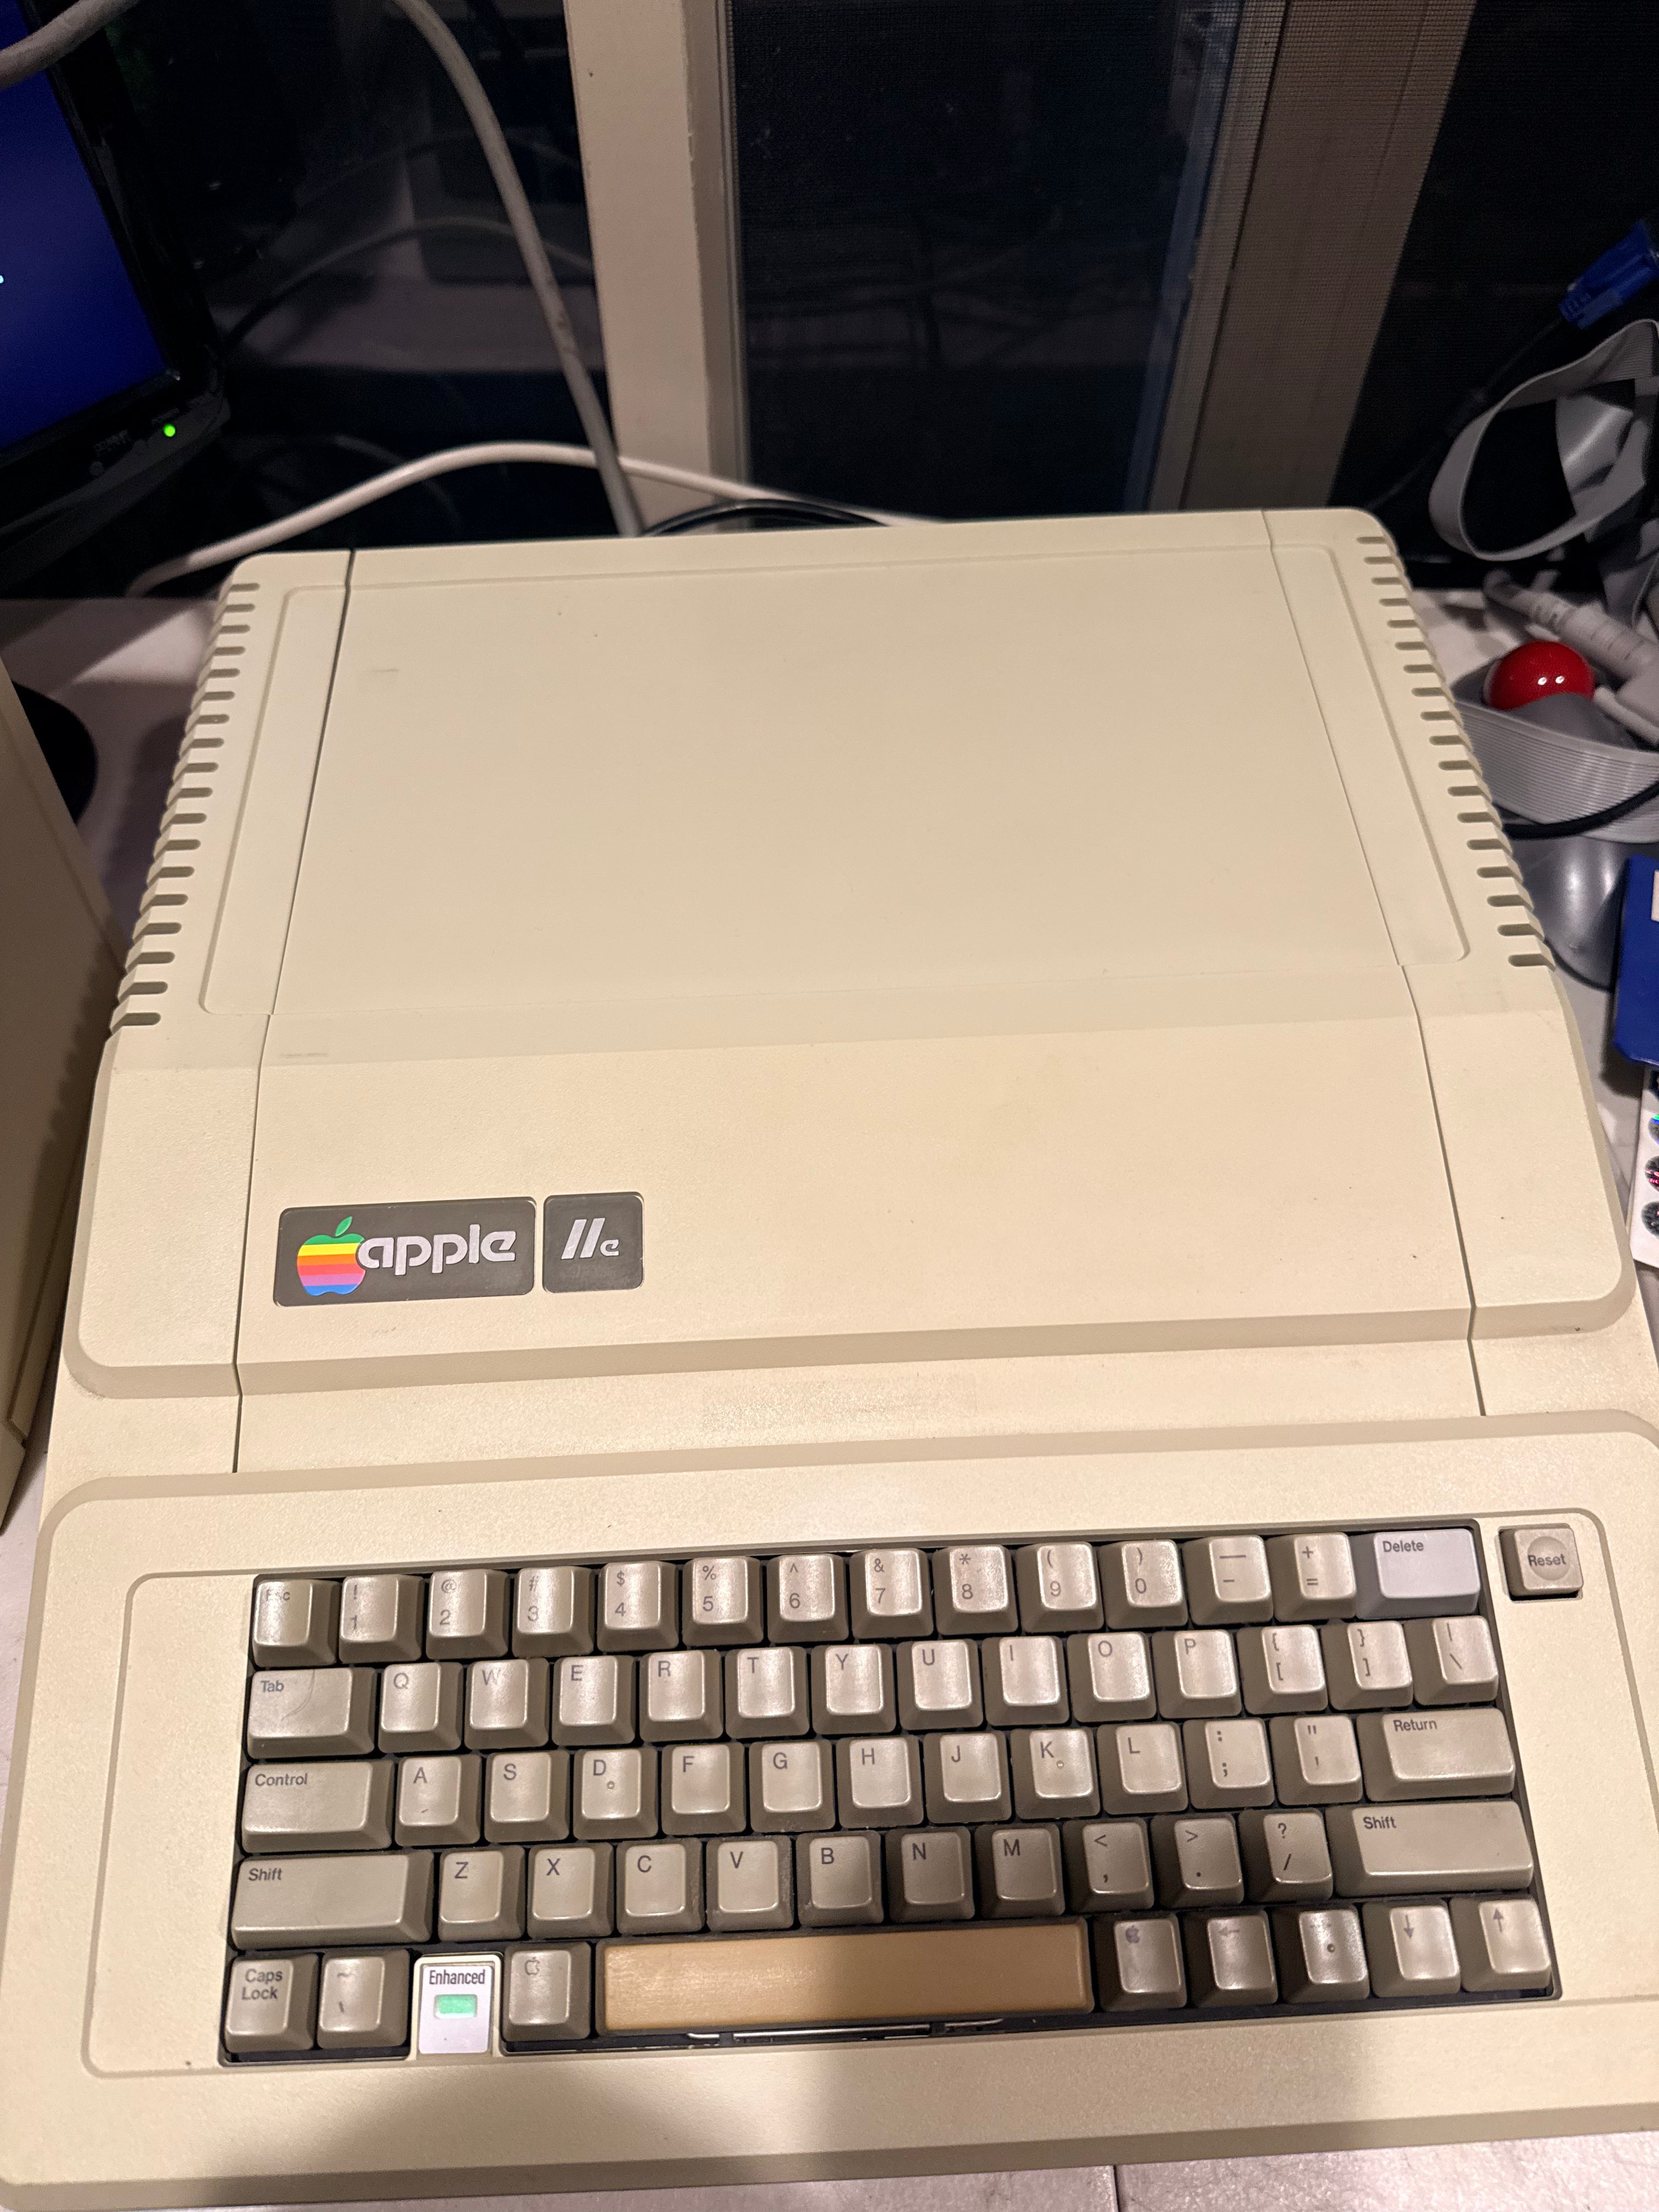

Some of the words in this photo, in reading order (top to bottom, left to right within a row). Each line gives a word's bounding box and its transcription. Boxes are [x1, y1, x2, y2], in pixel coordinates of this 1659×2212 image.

[358, 1224, 516, 1276] apple
[1301, 1546, 1313, 1559] +
[1383, 1541, 1424, 1552] Delete
[1047, 1550, 1053, 1568] (
[1138, 1549, 1144, 1564] )
[1528, 1553, 1566, 1567] Reset
[702, 1565, 716, 1581] %
[873, 1558, 884, 1572] &
[441, 1579, 457, 1593] @
[616, 1571, 625, 1587] $
[1135, 1578, 1147, 1594] 0
[875, 1588, 886, 1604] 7
[962, 1583, 973, 1599] 8
[1050, 1582, 1061, 1596] 9
[615, 1602, 626, 1616] 4
[702, 1595, 713, 1612] 5
[789, 1593, 800, 1609] 6
[439, 1609, 452, 1627] 2
[528, 1606, 539, 1622] 3
[1097, 1641, 1113, 1657] O
[1184, 1638, 1197, 1655] P
[747, 1657, 759, 1673] T
[836, 1654, 849, 1670] Y
[922, 1649, 935, 1666] U
[571, 1665, 583, 1681] E
[658, 1661, 671, 1677] R
[1276, 1662, 1283, 1681] [
[1362, 1658, 1370, 1677] ]
[393, 1673, 409, 1690] Q
[482, 1670, 501, 1685] W
[261, 1680, 284, 1693] Tab
[1393, 1719, 1437, 1731] Return
[1217, 1731, 1222, 1741] :
[1040, 1741, 1054, 1758] K
[1128, 1737, 1140, 1754] L
[773, 1752, 787, 1769] G
[862, 1748, 875, 1765] H
[951, 1746, 961, 1763] J
[503, 1763, 516, 1780] S
[593, 1759, 606, 1776] D
[683, 1756, 694, 1773] F
[255, 1773, 307, 1787] Control
[413, 1767, 427, 1784] A
[1278, 1822, 1286, 1838] ?
[1363, 1816, 1396, 1829] Shift
[1094, 1835, 1107, 1847] <
[1185, 1830, 1198, 1842] >
[821, 1848, 834, 1864] B
[912, 1843, 926, 1860] N
[1003, 1839, 1020, 1857] M
[546, 1858, 560, 1876] X
[637, 1855, 651, 1872] C
[730, 1852, 743, 1869] V
[1283, 1854, 1291, 1870] /
[249, 1868, 282, 1881] Shift
[455, 1862, 469, 1879] Z
[245, 1968, 283, 1983] Caps
[429, 1970, 485, 1985] Enhanced
[241, 1986, 278, 2000] Lock
